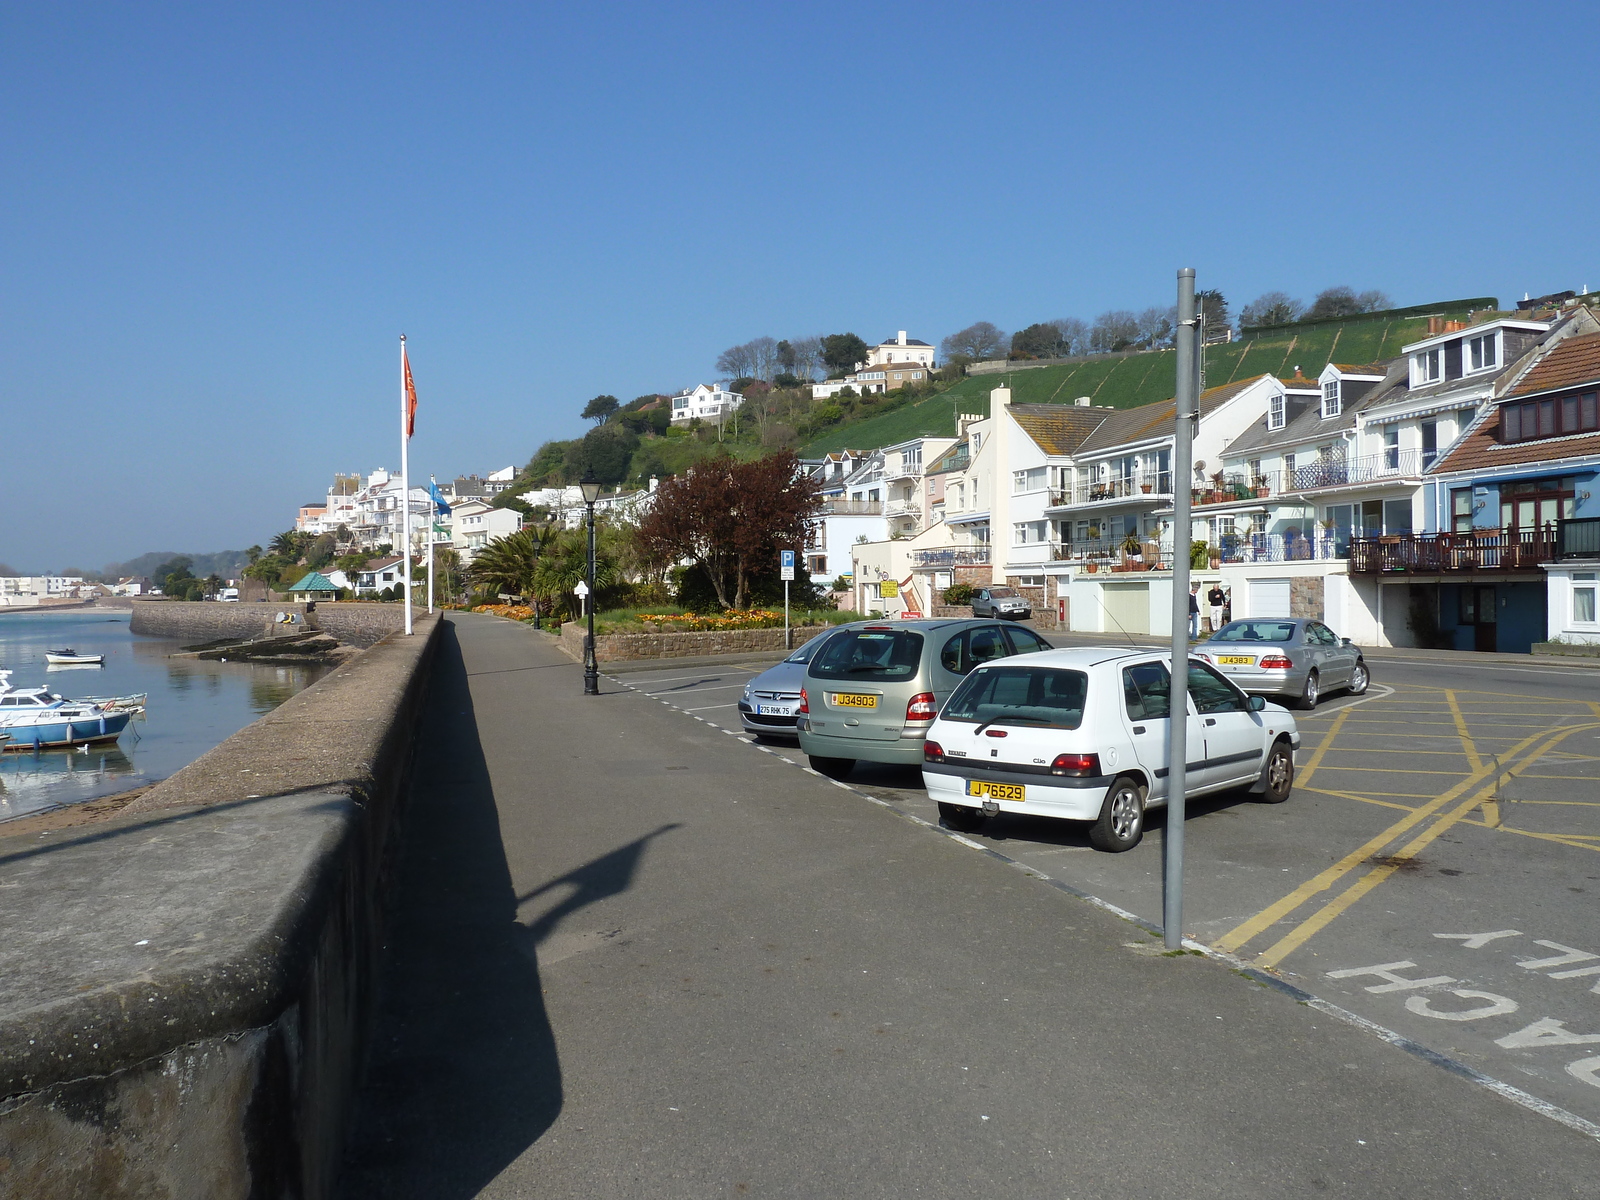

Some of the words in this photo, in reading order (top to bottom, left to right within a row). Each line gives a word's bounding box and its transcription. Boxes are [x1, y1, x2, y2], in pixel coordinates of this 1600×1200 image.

[783, 552, 792, 566] P
[839, 695, 875, 707] J34903
[760, 706, 770, 714] 275
[781, 707, 790, 715] 75
[974, 783, 981, 794] J
[984, 784, 1022, 799] 76529
